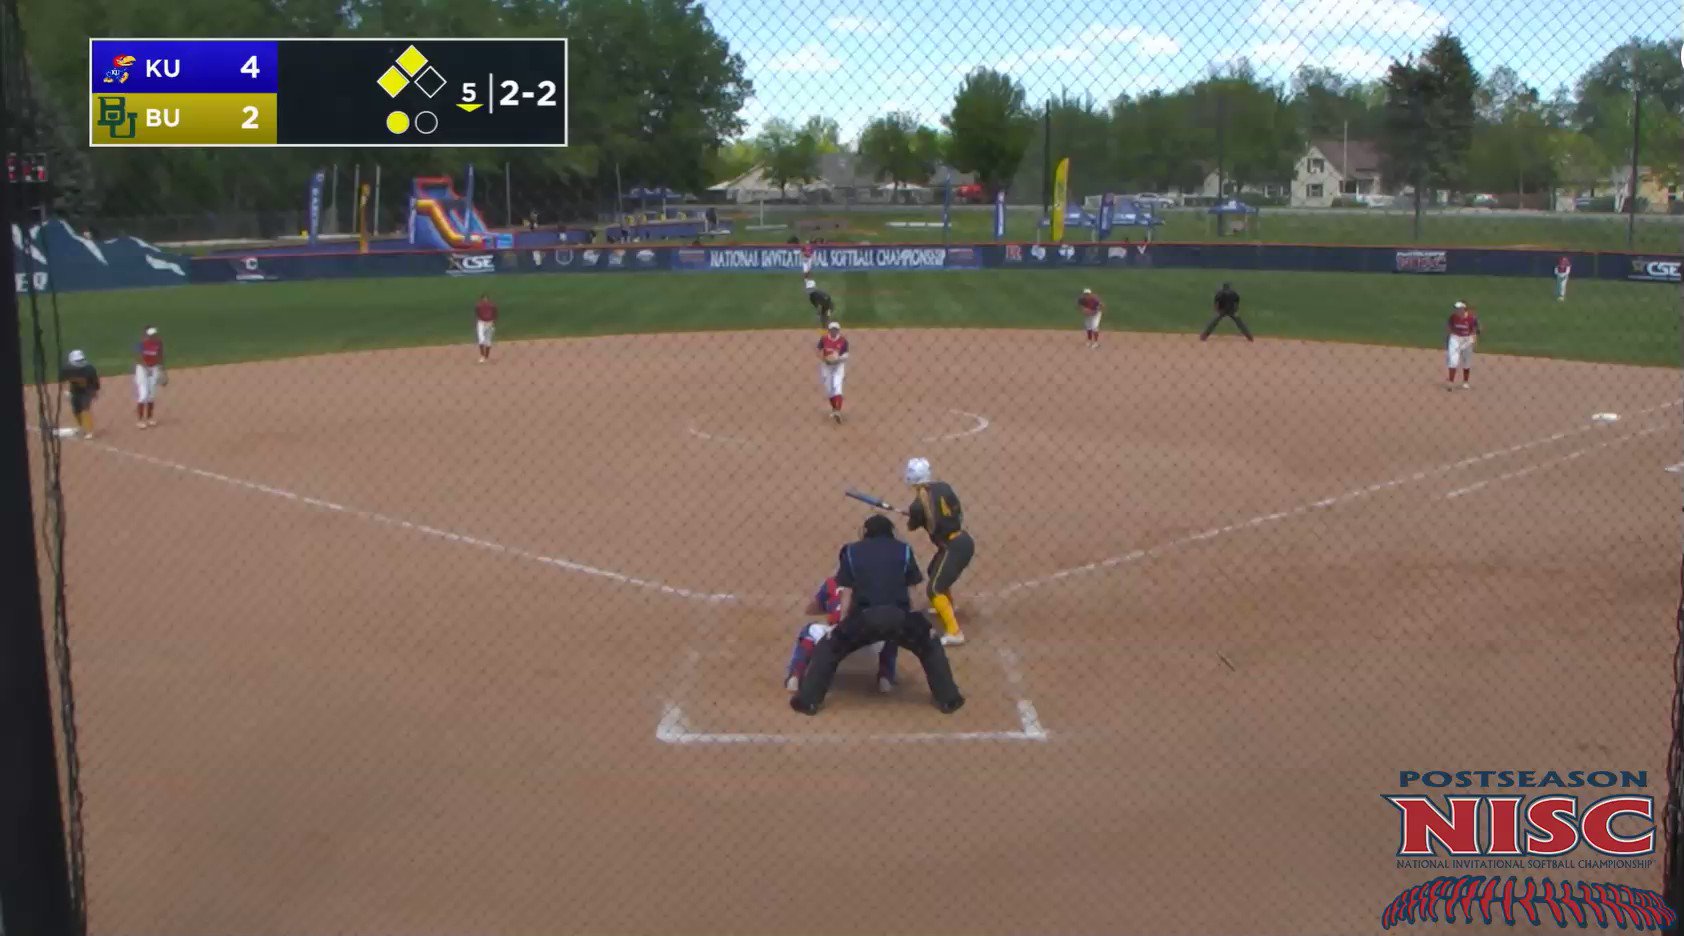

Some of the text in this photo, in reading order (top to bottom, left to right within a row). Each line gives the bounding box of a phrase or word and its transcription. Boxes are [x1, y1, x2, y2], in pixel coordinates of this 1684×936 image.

[710, 249, 758, 267] NATIONAL
[830, 249, 874, 266] SOFTBALL
[876, 248, 946, 267] CHAMPIONSHIP
[1646, 261, 1682, 277] CSE
